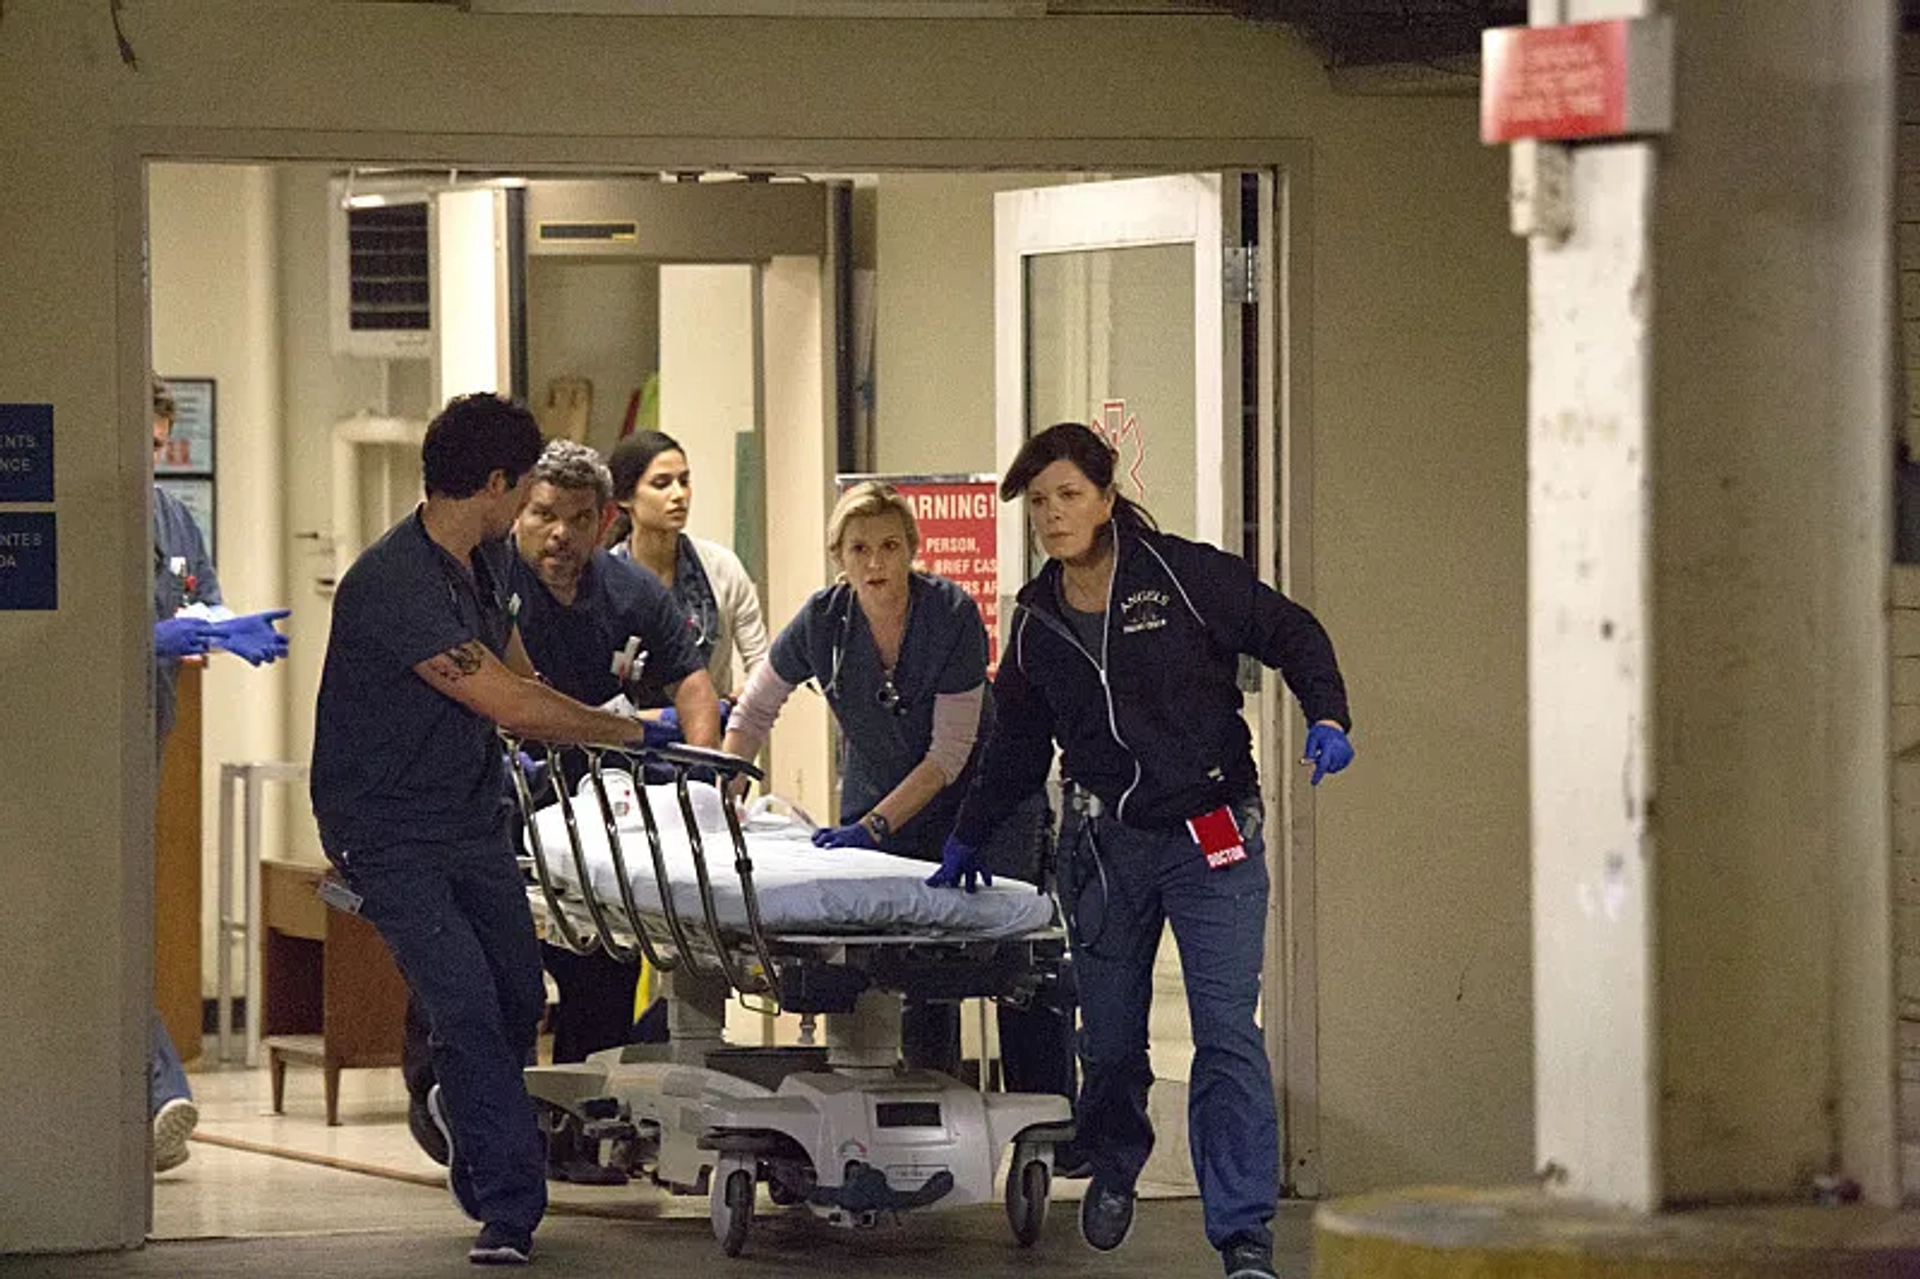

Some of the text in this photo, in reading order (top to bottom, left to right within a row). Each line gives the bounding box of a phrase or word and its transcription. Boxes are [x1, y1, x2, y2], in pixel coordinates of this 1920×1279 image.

[926, 537, 980, 553] PERSON,
[934, 559, 971, 574] BRIEF
[1206, 845, 1247, 869] DOCTOR
